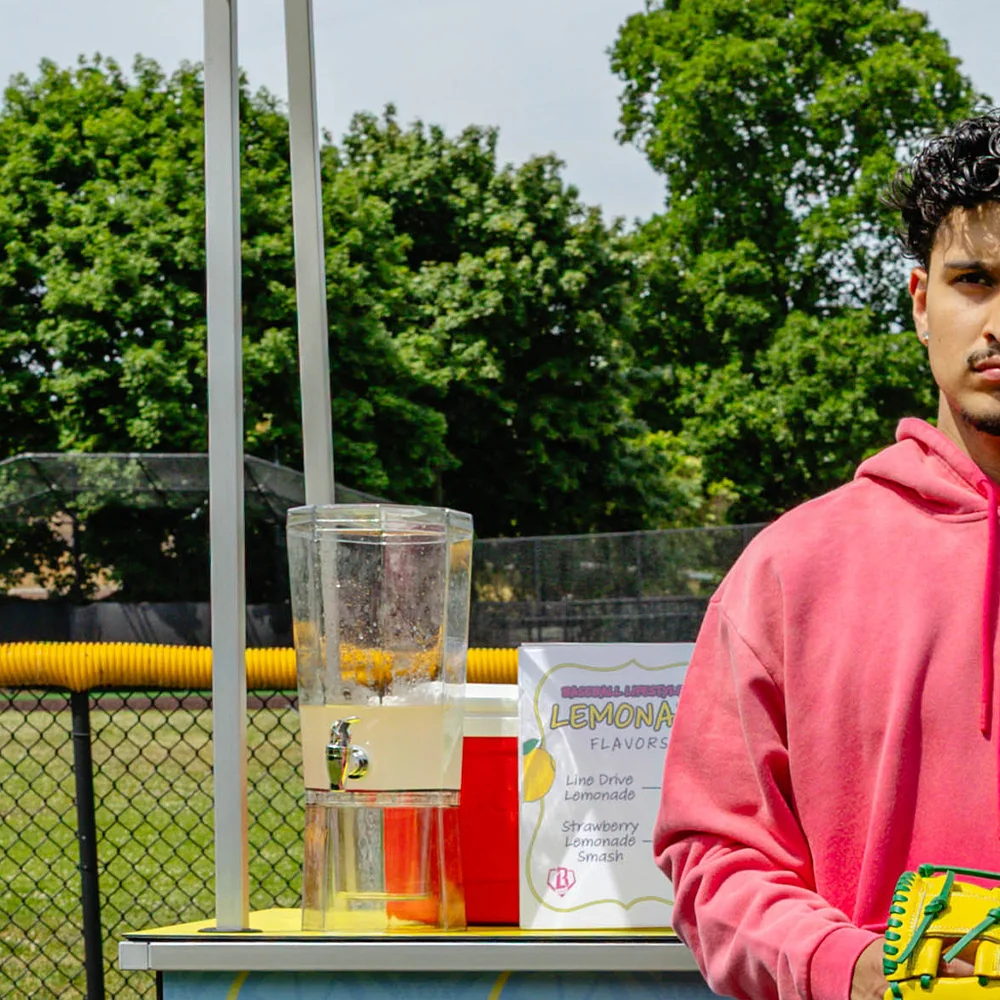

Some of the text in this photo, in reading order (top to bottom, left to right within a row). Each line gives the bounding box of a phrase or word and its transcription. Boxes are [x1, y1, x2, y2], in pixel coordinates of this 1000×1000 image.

[549, 700, 676, 732] LEMONA
[590, 736, 669, 751] FLAVORS
[566, 773, 633, 786] Line Drive
[565, 788, 636, 801] Lemonade
[562, 820, 639, 835] Strawberry
[565, 834, 636, 848] Lemonade
[577, 850, 623, 862] Smash
